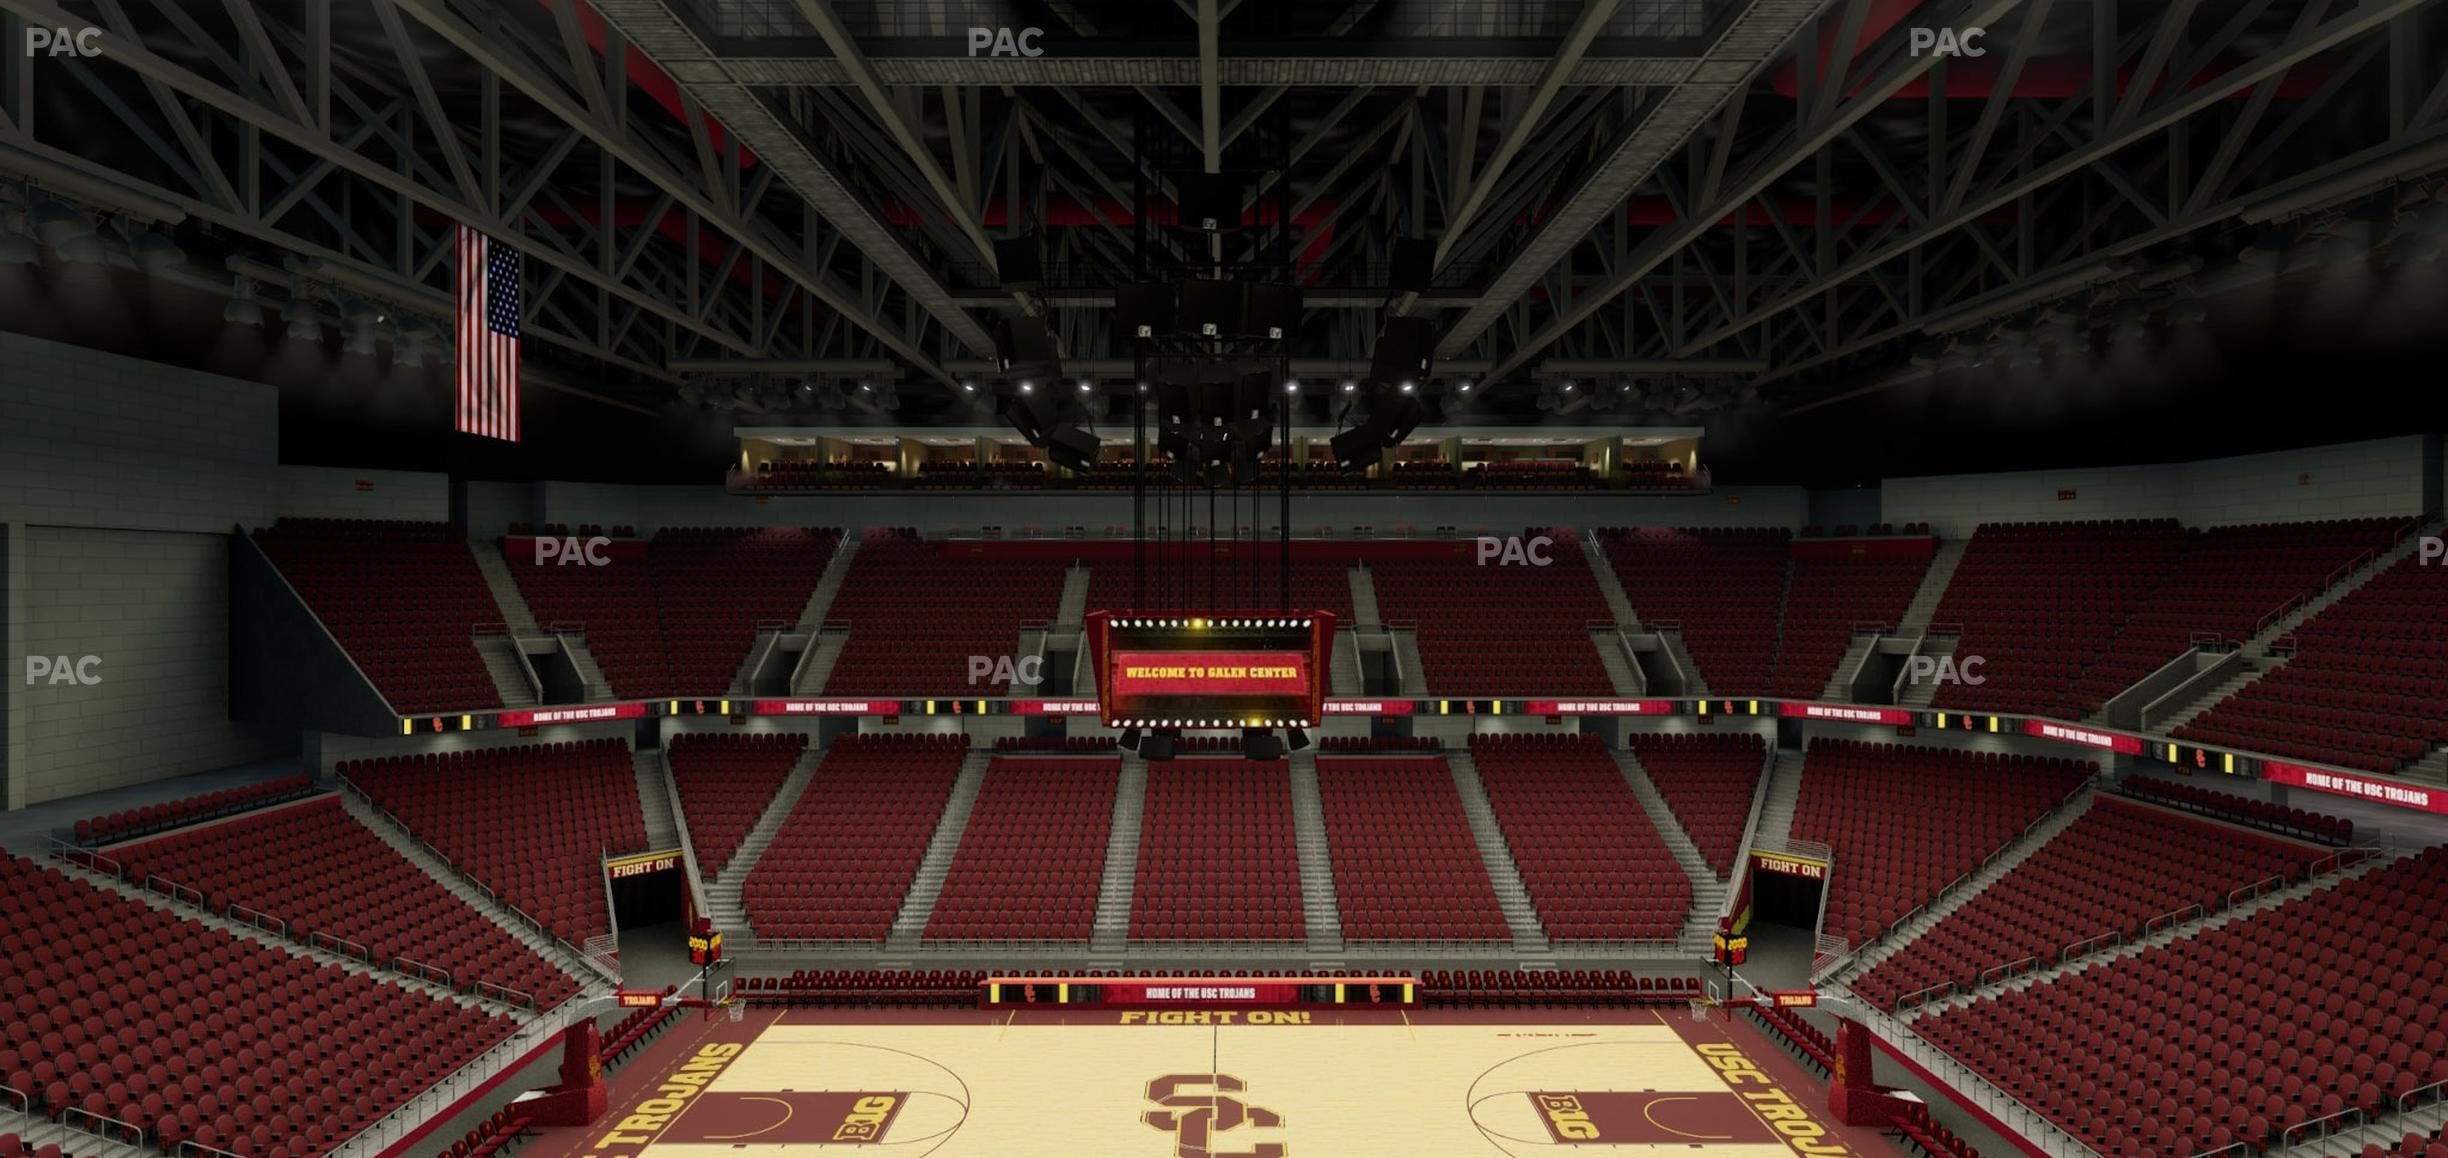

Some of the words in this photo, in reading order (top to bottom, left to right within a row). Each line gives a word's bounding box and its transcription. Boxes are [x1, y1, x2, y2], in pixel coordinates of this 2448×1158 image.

[1126, 667, 1186, 678] WELCOME
[1188, 667, 1205, 678] TO
[1207, 667, 1246, 678] GALEN
[1249, 667, 1297, 678] CENTER
[2305, 772, 2331, 788] HOME
[2332, 777, 2344, 790] OF
[2345, 779, 2363, 794] THE
[2364, 782, 2384, 798] USC
[2384, 786, 2428, 806] TROJANS
[613, 861, 653, 878] FIGHT
[656, 858, 675, 871] ON
[1761, 858, 1799, 874] FIGHT
[1802, 864, 1821, 878] ON
[1146, 988, 1170, 999] HOME
[1171, 988, 1182, 999] OF
[1183, 988, 1200, 999] THE
[1201, 988, 1218, 999] USC
[1219, 988, 1256, 999] TROJANS
[1119, 1011, 1238, 1025] FIGHT
[1247, 1011, 1312, 1025] ON!
[1696, 1043, 1772, 1084] USC
[594, 1043, 743, 1149] TROJANS
